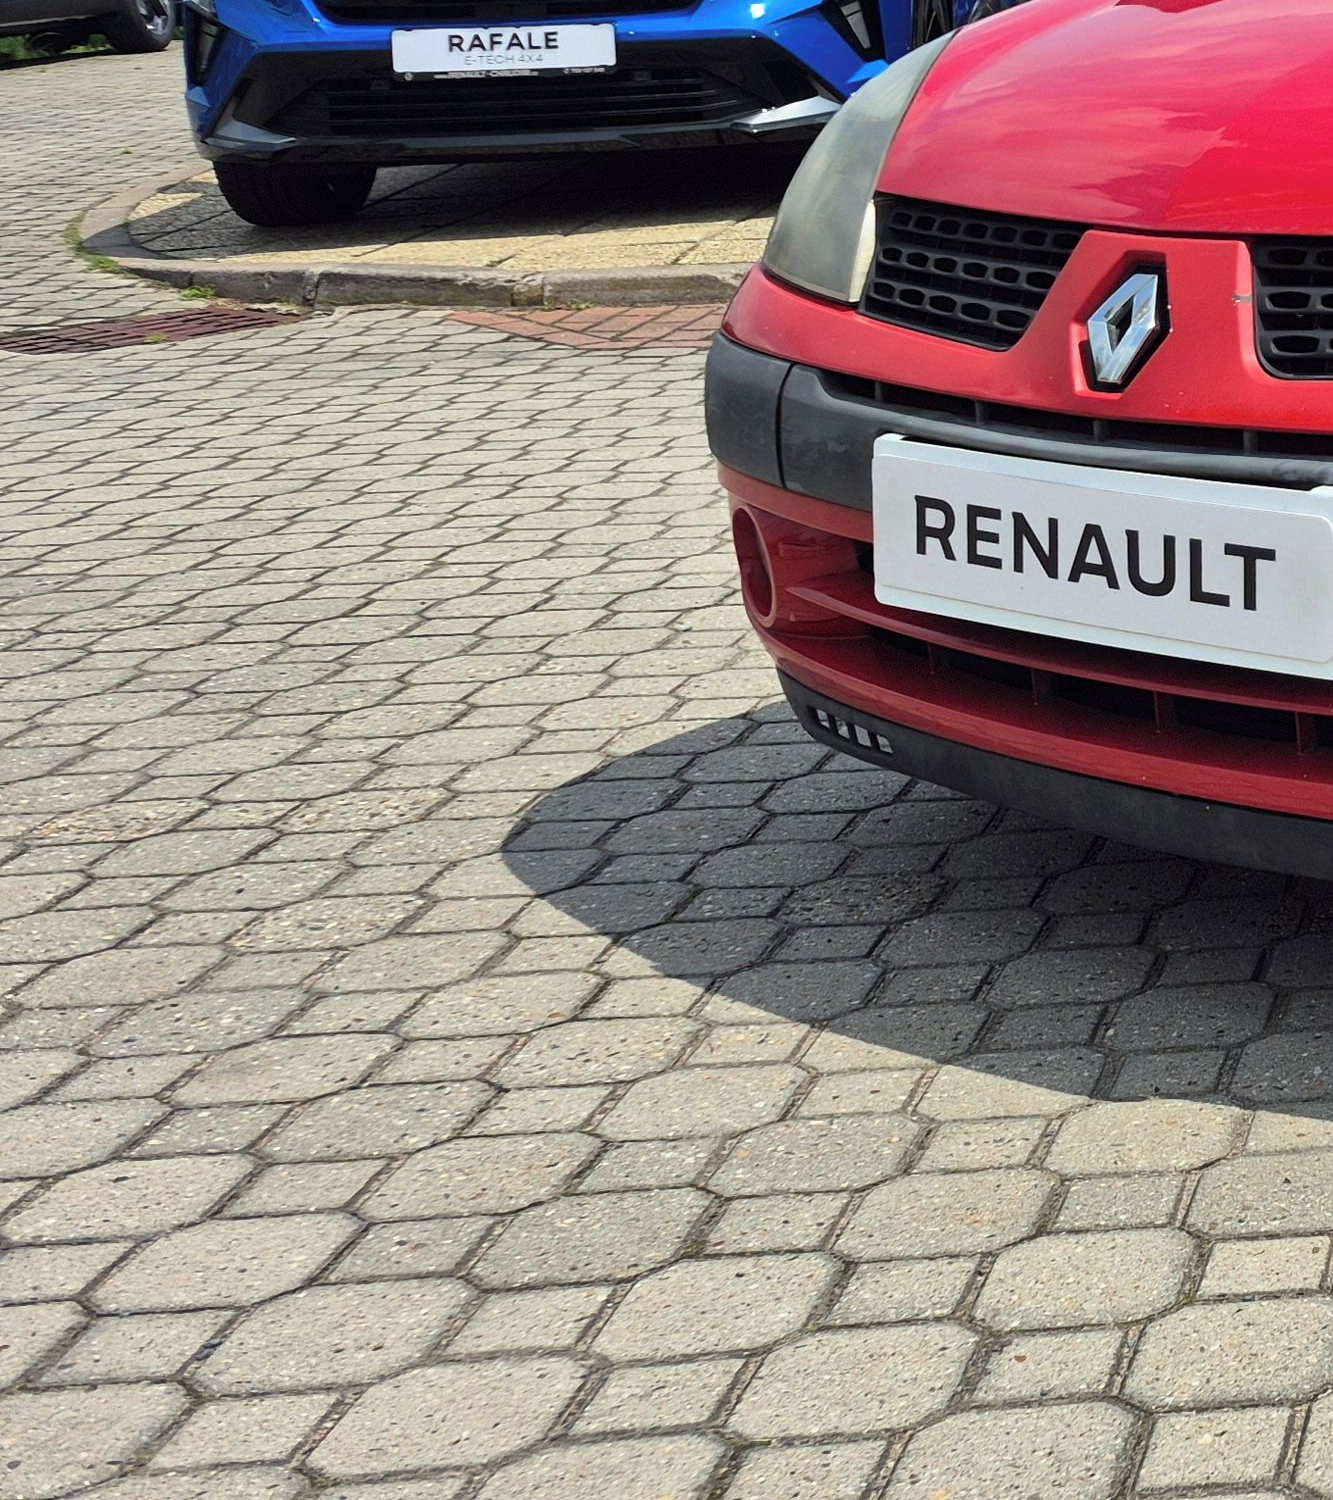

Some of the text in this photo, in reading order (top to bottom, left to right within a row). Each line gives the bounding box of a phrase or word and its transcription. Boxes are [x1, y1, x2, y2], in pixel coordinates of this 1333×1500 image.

[448, 31, 559, 53] RAFALE
[464, 53, 544, 66] E-TECH 4X4
[914, 494, 1277, 611] RENAULT
